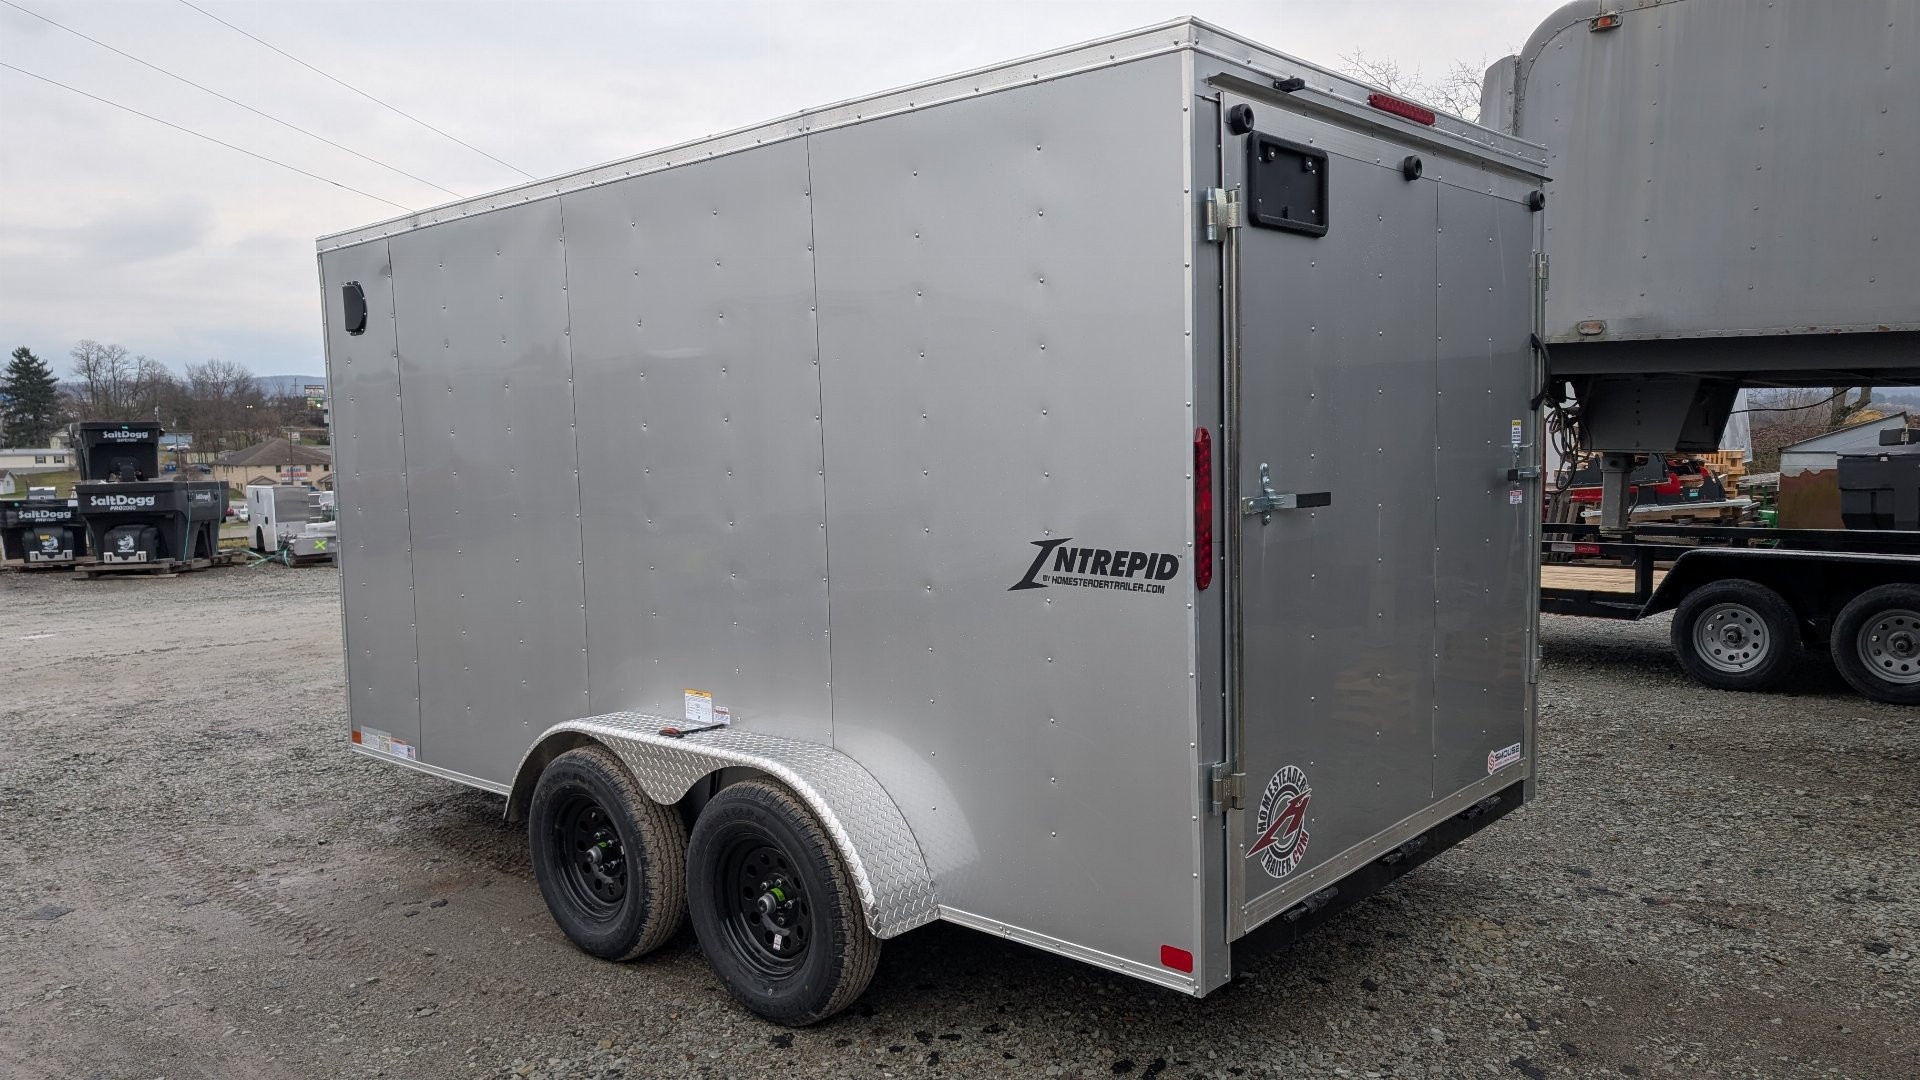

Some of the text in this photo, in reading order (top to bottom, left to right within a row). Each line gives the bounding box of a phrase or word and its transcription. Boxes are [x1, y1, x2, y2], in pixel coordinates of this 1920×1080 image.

[102, 430, 149, 439] SaltDogg
[90, 494, 155, 506] SaltDogg
[18, 509, 72, 519] SaltDogg
[1007, 537, 1180, 591] INTREPID
[1051, 575, 1166, 595] HOMESTEADERTRAILER.COM
[1257, 766, 1307, 834] HOMESTEADER
